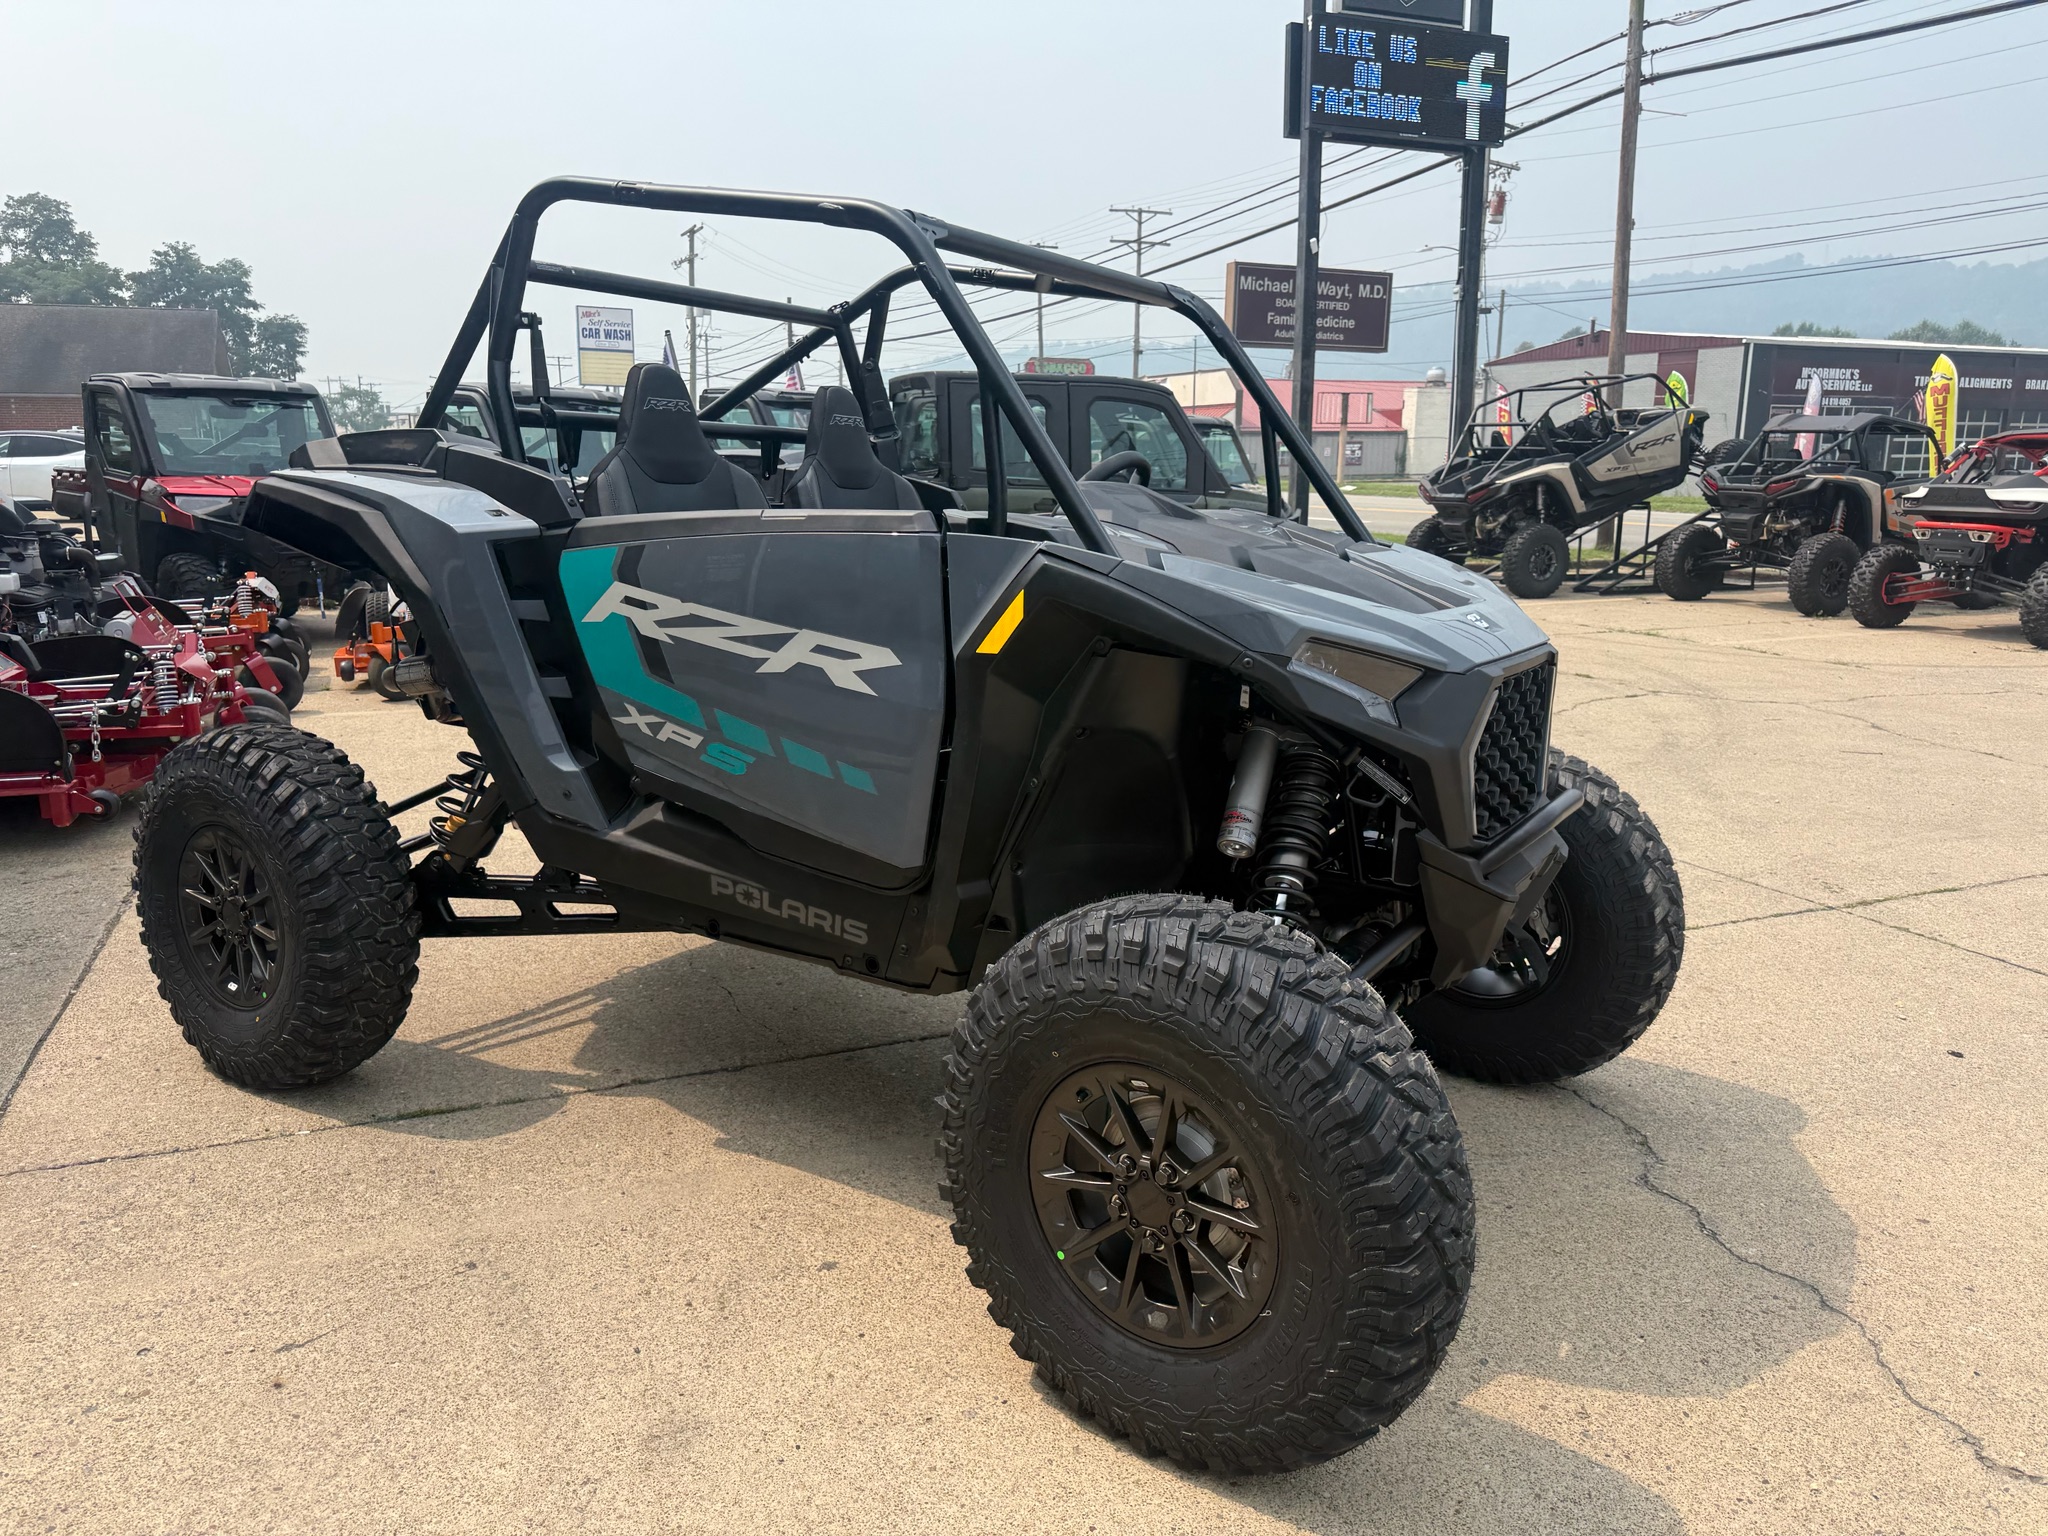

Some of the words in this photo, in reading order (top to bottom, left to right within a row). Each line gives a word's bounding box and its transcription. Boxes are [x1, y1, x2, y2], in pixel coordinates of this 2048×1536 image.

[1319, 25, 1376, 59] LIKE
[1389, 34, 1418, 64] US
[1353, 60, 1382, 89] ON
[1311, 84, 1423, 123] FACEBOOK
[1239, 275, 1294, 294] Michael
[1317, 281, 1353, 299] Wayt,
[1358, 284, 1387, 299] M.D.
[1275, 298, 1296, 308] BOA
[588, 318, 604, 328] Self
[604, 319, 631, 328] Service
[1267, 312, 1296, 325] Famil
[1316, 315, 1356, 329] edicine
[581, 327, 601, 340] CAR
[603, 328, 632, 342] WASH
[1316, 332, 1344, 341] diatrics
[1822, 379, 1861, 392] SERVICE
[1861, 383, 1873, 392] LLC
[1959, 376, 2013, 390] ALIGNMENTS
[643, 396, 691, 412] RZR
[829, 413, 864, 428] RZR
[1631, 433, 1676, 455] RZR
[581, 581, 903, 697] RZR
[711, 874, 869, 946] POLARIS
